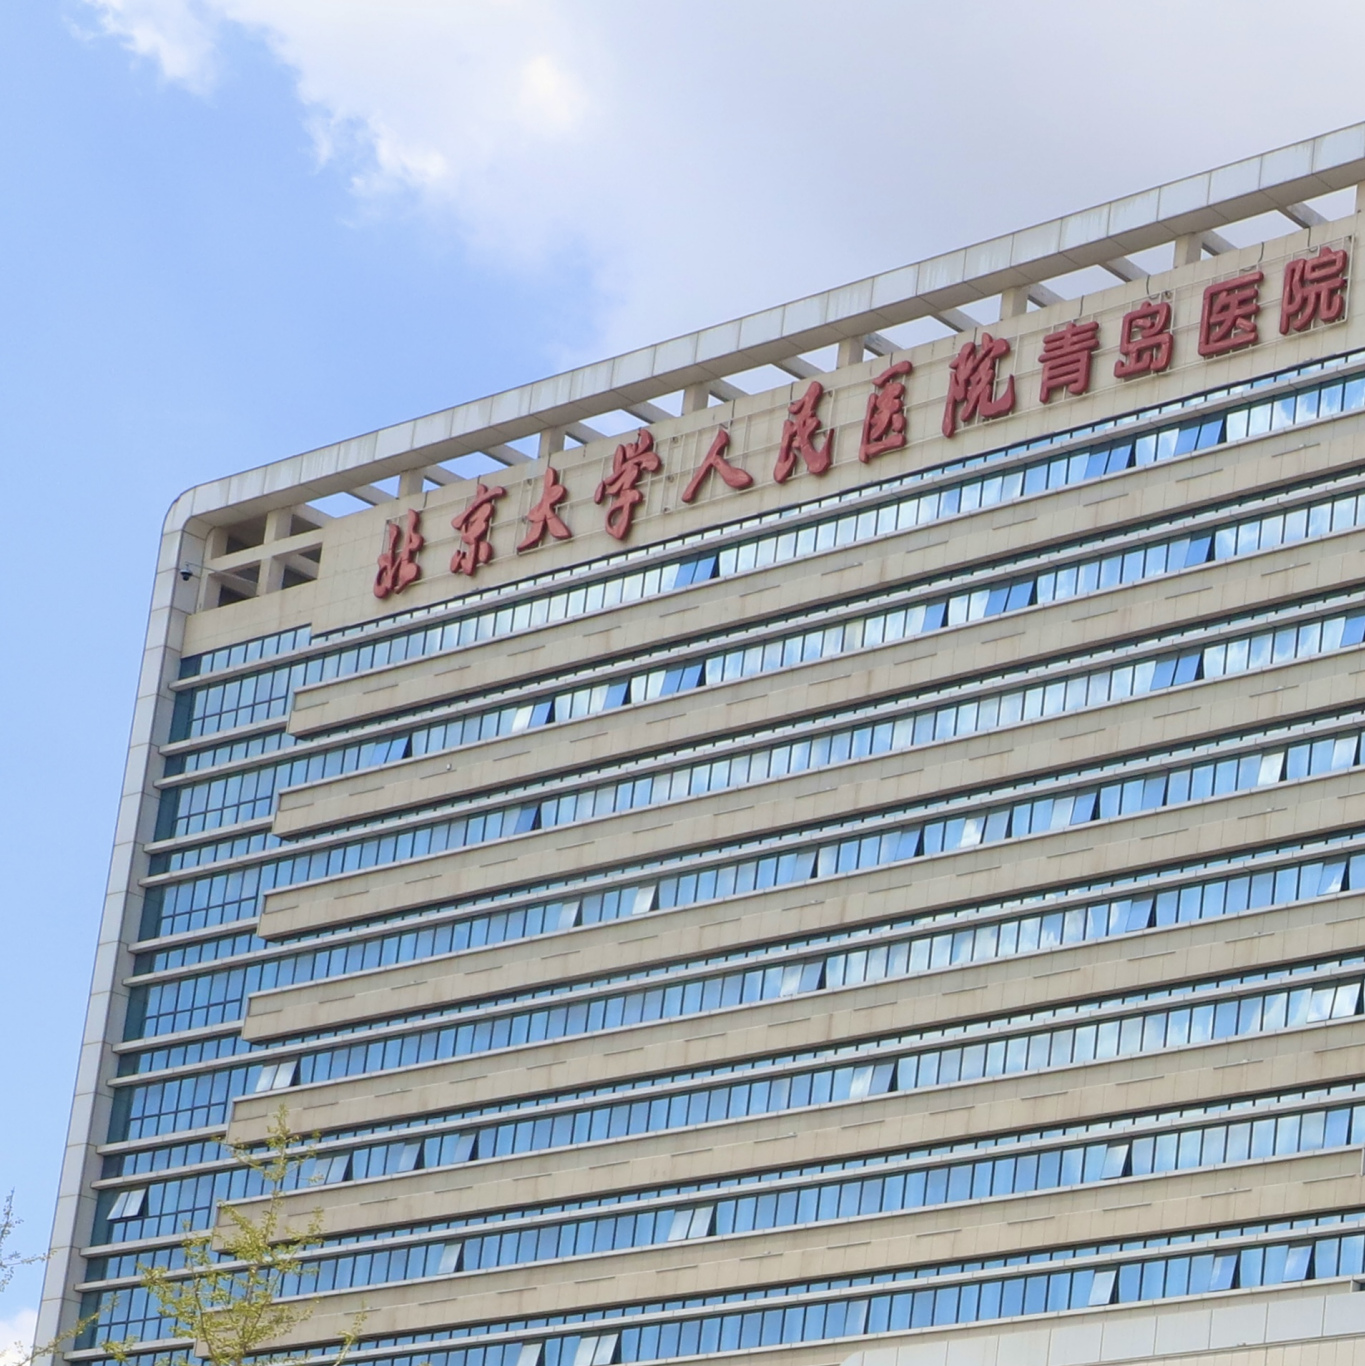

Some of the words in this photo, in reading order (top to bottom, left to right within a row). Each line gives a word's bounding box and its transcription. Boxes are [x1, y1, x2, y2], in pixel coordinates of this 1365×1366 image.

[373, 246, 1348, 598] 北京大学人民医院青岛医院
